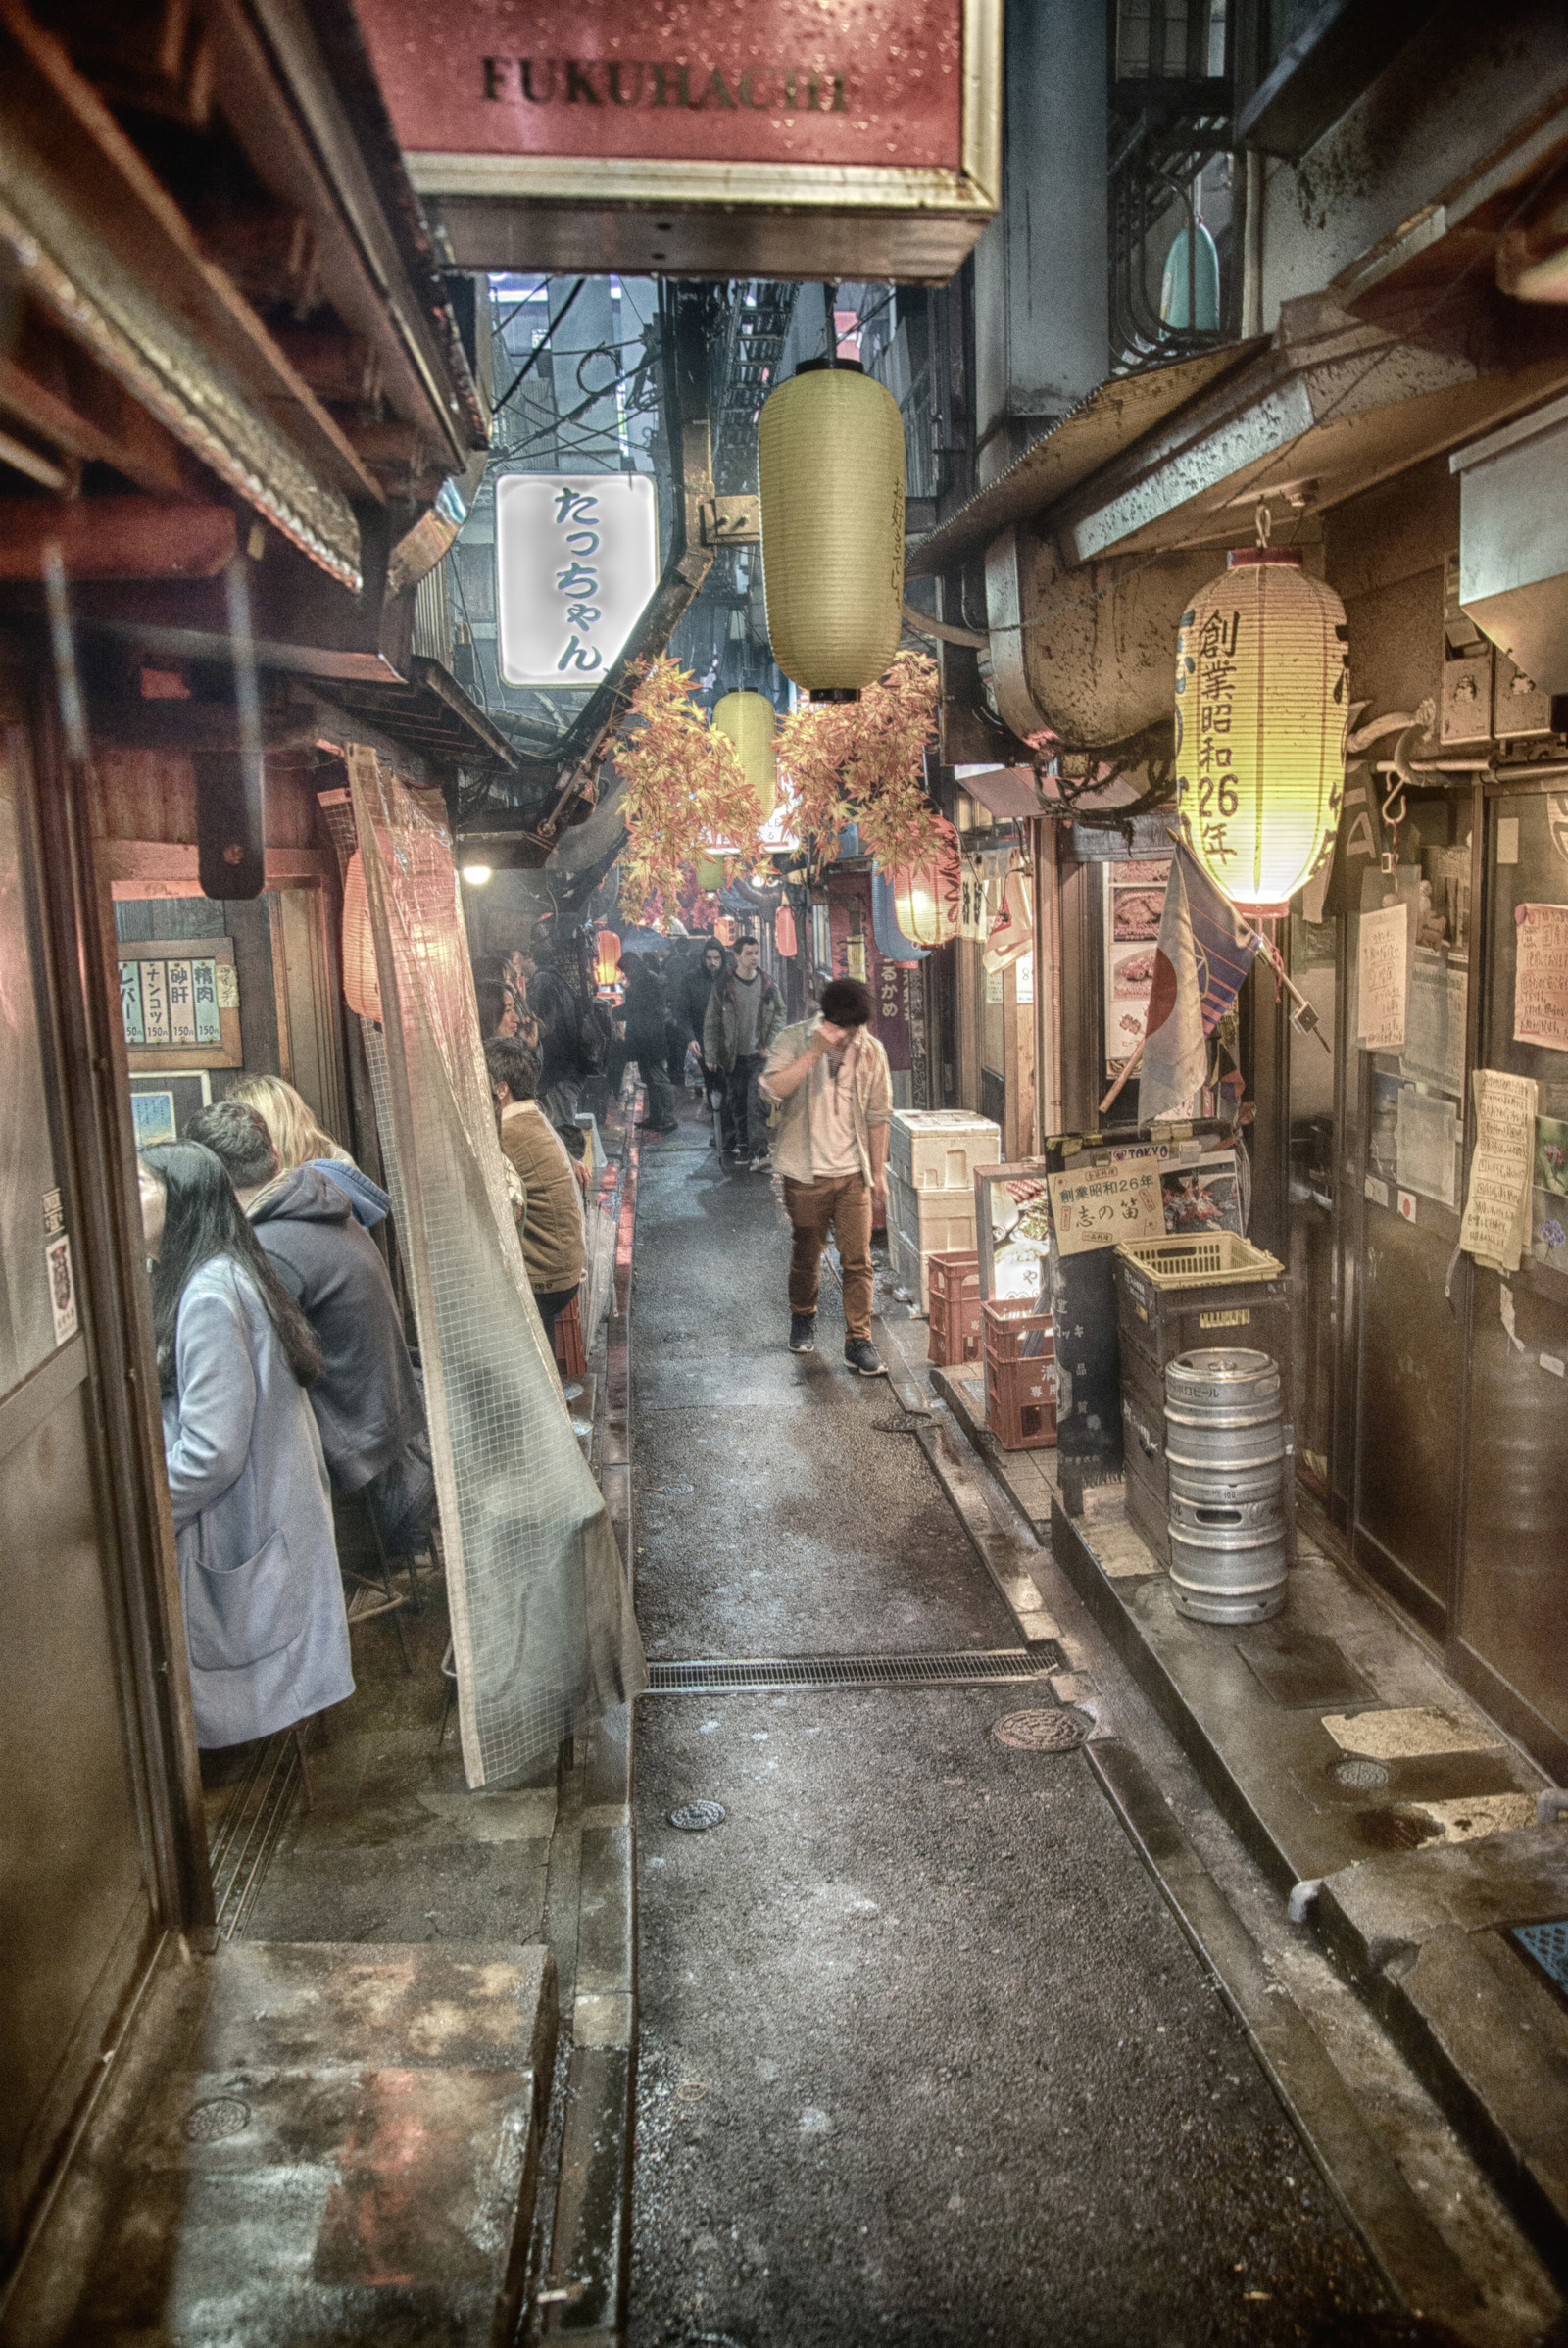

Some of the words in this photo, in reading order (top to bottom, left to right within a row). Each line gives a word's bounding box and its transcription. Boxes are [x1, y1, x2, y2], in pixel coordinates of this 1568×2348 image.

[480, 55, 849, 112] FUKUHACHI
[555, 487, 602, 670] たっちゃん
[1198, 608, 1241, 866] 創業昭和26年
[120, 969, 135, 1019] レバー
[146, 968, 163, 1023] ナンコツ
[170, 967, 189, 1003] 砂肝
[194, 965, 214, 1003] 精肉
[881, 957, 898, 1017] るかめ
[126, 1026, 143, 1037] 50円
[1059, 1174, 1154, 1203] 創業昭和26年
[1076, 1196, 1140, 1228] 志の笛
